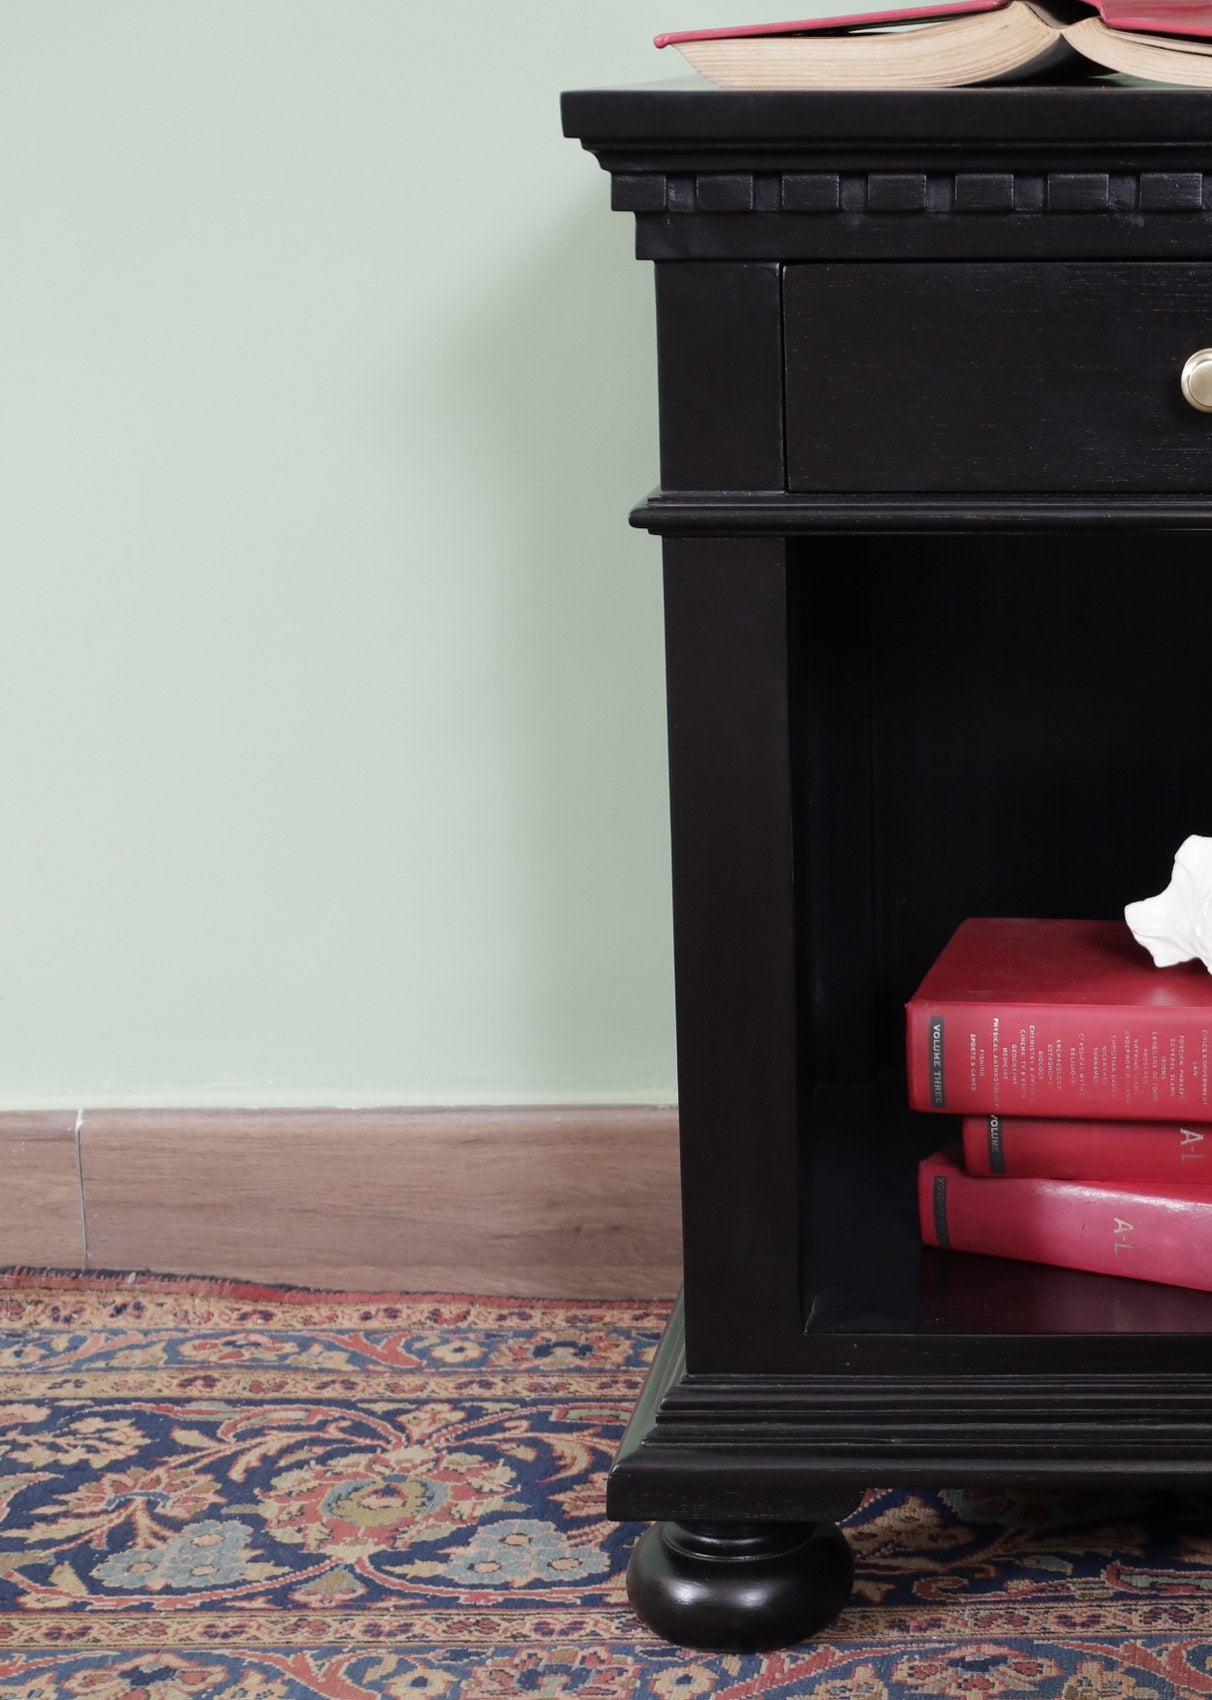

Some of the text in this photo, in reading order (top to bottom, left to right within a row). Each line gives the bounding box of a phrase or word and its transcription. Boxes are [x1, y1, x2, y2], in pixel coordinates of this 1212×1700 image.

[933, 1024, 943, 1104] VOLUME THREE
[970, 1033, 978, 1060] SPORTS
[970, 1068, 978, 1092] GAMES
[1180, 1127, 1205, 1169] A-L
[1113, 1216, 1135, 1259] A-L
